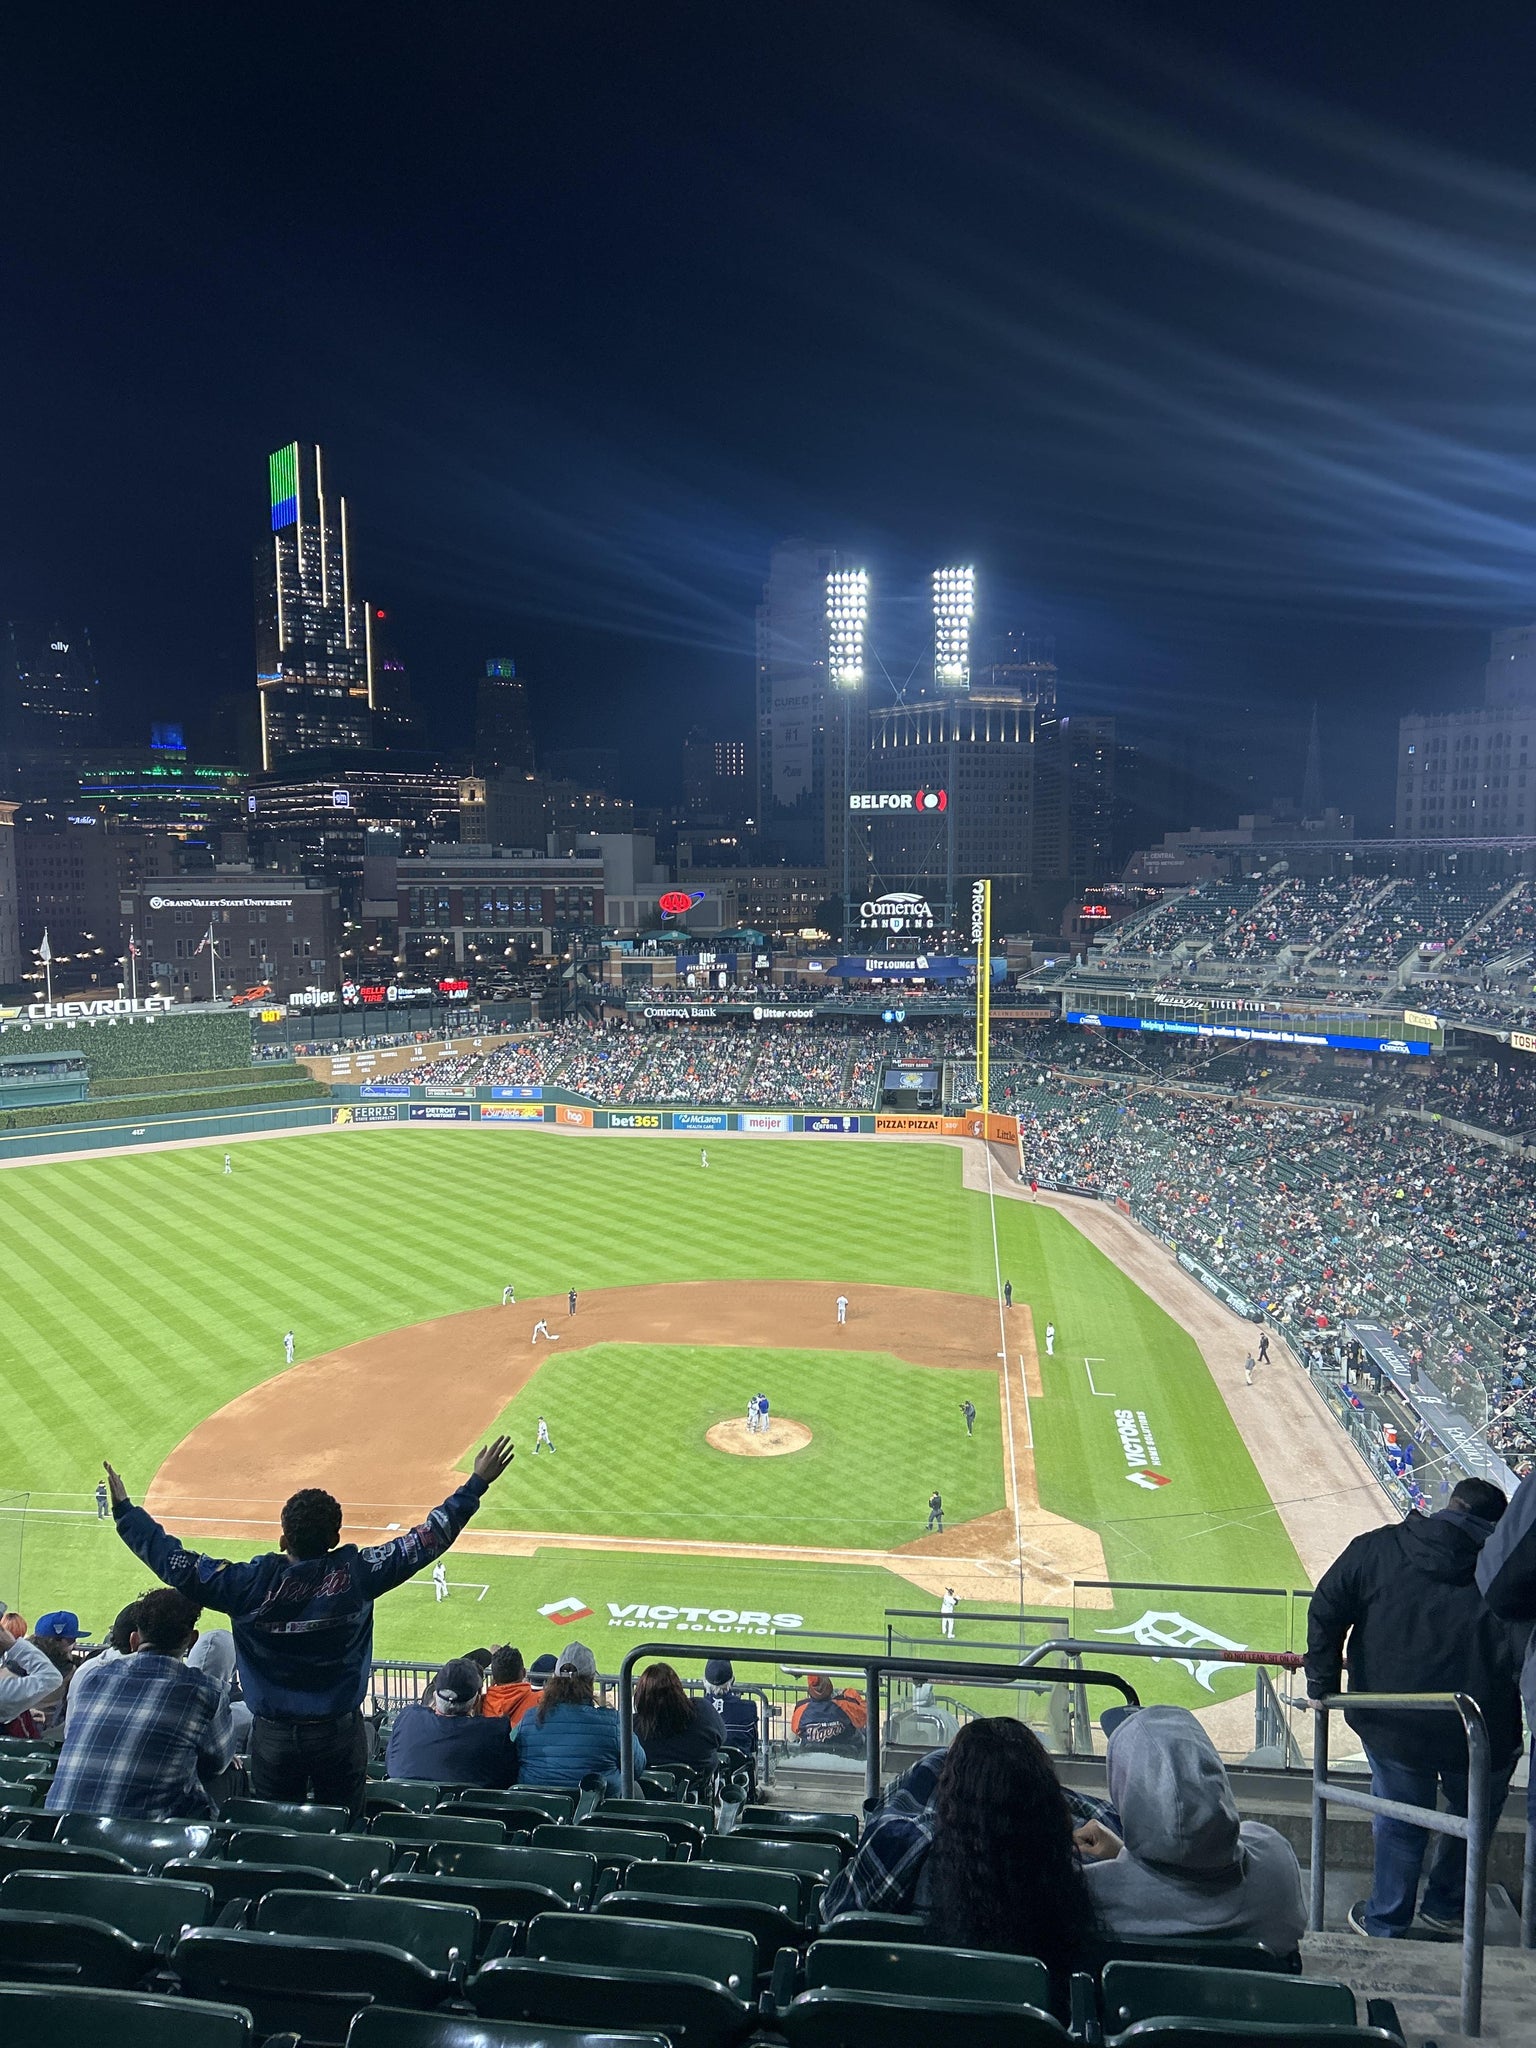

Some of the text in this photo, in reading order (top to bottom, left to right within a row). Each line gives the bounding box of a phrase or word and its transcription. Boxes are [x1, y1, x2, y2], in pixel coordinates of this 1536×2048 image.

[50, 641, 69, 653] ally
[850, 795, 912, 808] BELFOR
[971, 894, 985, 945] Rocket
[699, 952, 717, 966] Lite
[866, 959, 915, 971] Lite LOUNGE
[360, 987, 386, 995] BELLE
[448, 990, 469, 999] LAW
[289, 991, 335, 1007] meijer
[363, 995, 383, 1003] TIRE
[28, 996, 176, 1019] CHEVROLET
[1211, 1000, 1266, 1012] TIGER CLUB
[691, 1008, 717, 1017] Bank
[1021, 1009, 1049, 1018] CORNER
[0, 1016, 155, 1034] FOUNTAIN
[1140, 1020, 1164, 1032] Helping
[1164, 1023, 1198, 1034] businesses
[355, 1107, 396, 1117] FERRIS
[567, 1110, 582, 1122] hap
[611, 1114, 659, 1127] bet365
[690, 1114, 722, 1124] McLaren
[749, 1117, 781, 1129] meijer
[876, 1120, 938, 1130] PIZZA! PIZZA!
[812, 1121, 838, 1130] Corona
[996, 1128, 1015, 1142] Little
[1113, 1409, 1148, 1467] VICTORS
[606, 1602, 804, 1628] VICTORS
[608, 1619, 668, 1630] HOME
[1223, 1652, 1233, 1660] DO
